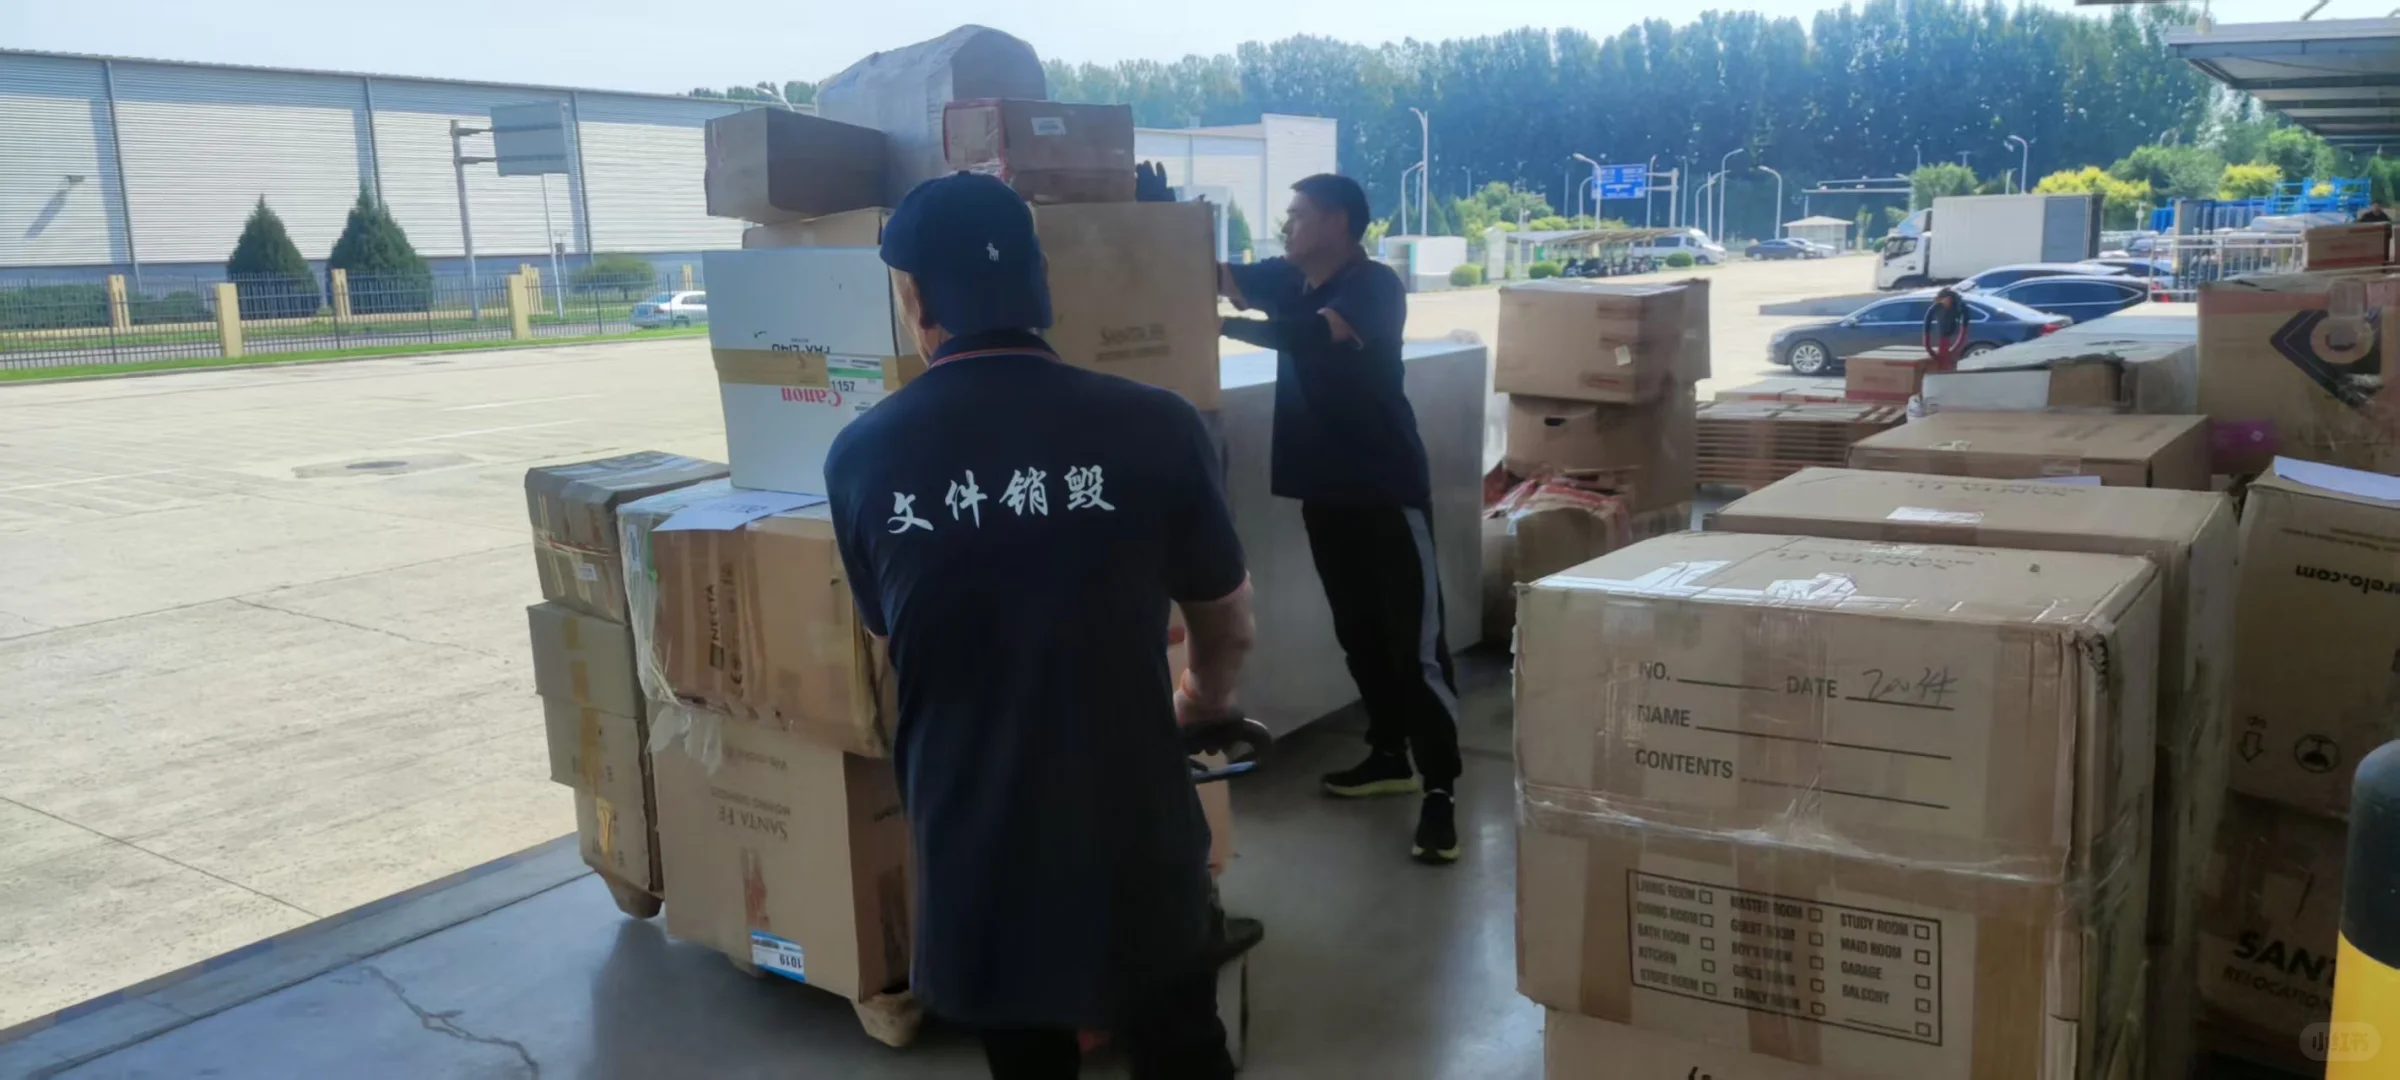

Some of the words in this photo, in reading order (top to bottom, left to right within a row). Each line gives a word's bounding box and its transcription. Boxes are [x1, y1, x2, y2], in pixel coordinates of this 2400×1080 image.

[781, 387, 843, 407] Canon
[831, 380, 855, 392] 1157
[887, 464, 1116, 534] 文件销毁
[2295, 564, 2400, 595] relo.com
[1786, 675, 1838, 699] DATE
[1637, 704, 1692, 728] NAME
[1635, 748, 1733, 779] CONTENTS
[718, 804, 735, 826] FE
[740, 812, 788, 840] SANTA
[1877, 919, 1909, 936] ROOM
[779, 954, 802, 969] 1019
